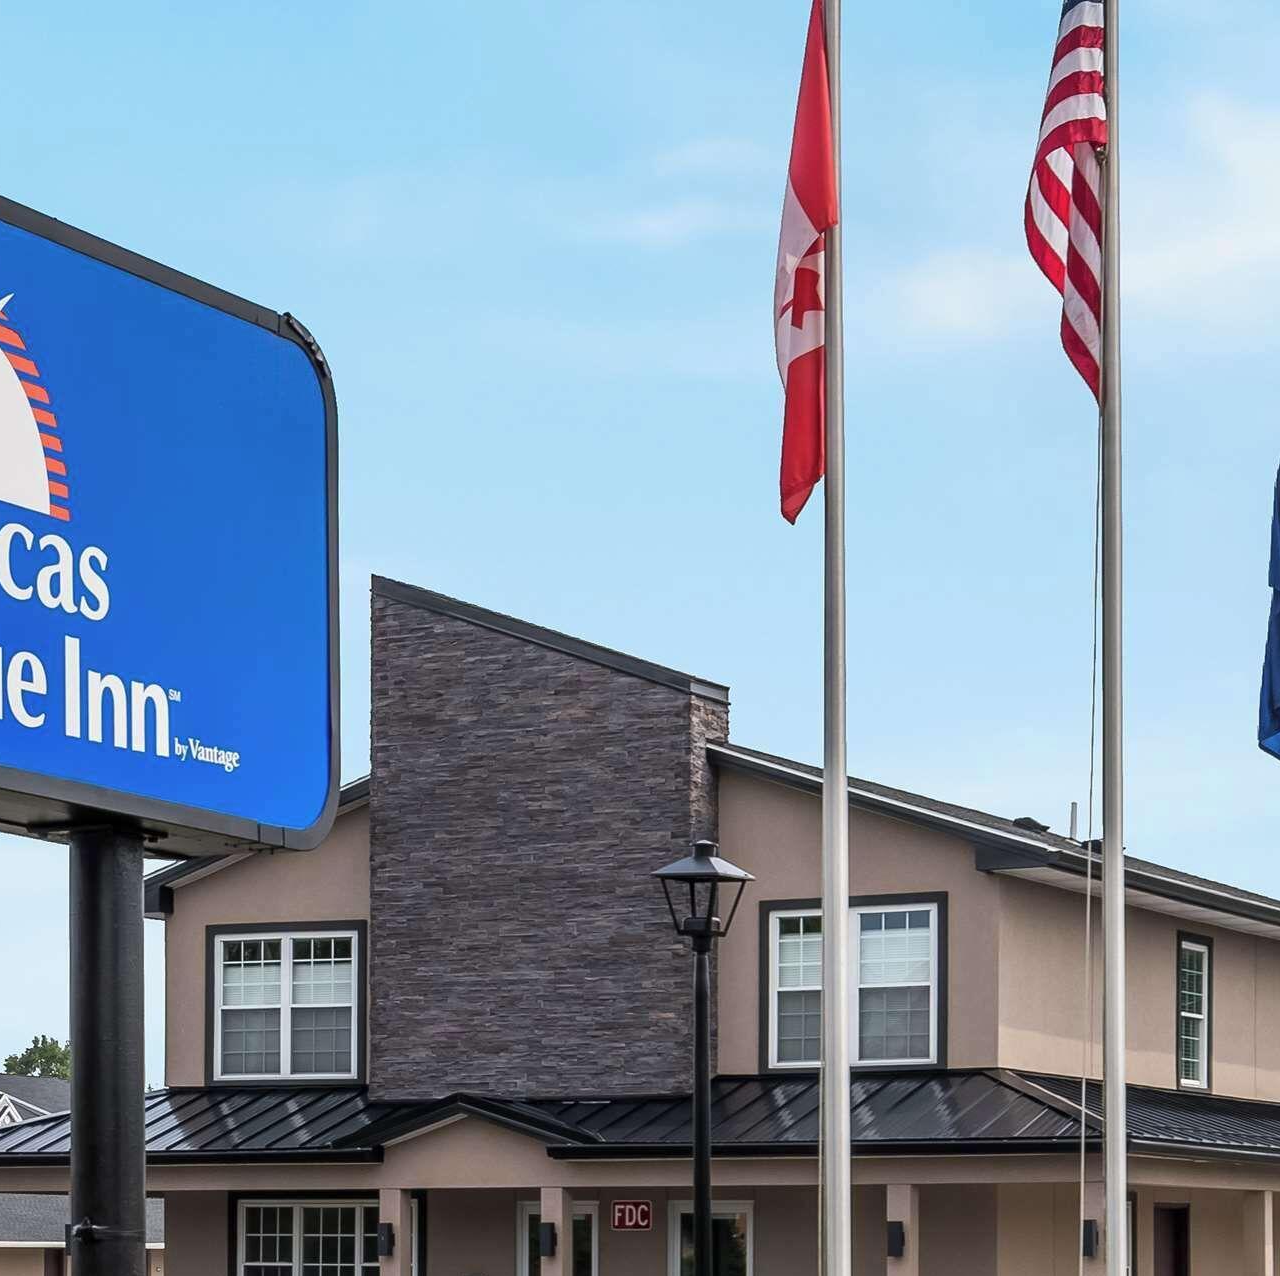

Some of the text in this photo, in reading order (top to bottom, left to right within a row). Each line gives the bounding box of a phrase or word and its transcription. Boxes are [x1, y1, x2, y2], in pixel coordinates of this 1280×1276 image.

[64, 635, 170, 758] Inn
[174, 737, 241, 773] by Vantage
[614, 1203, 649, 1227] FDC
